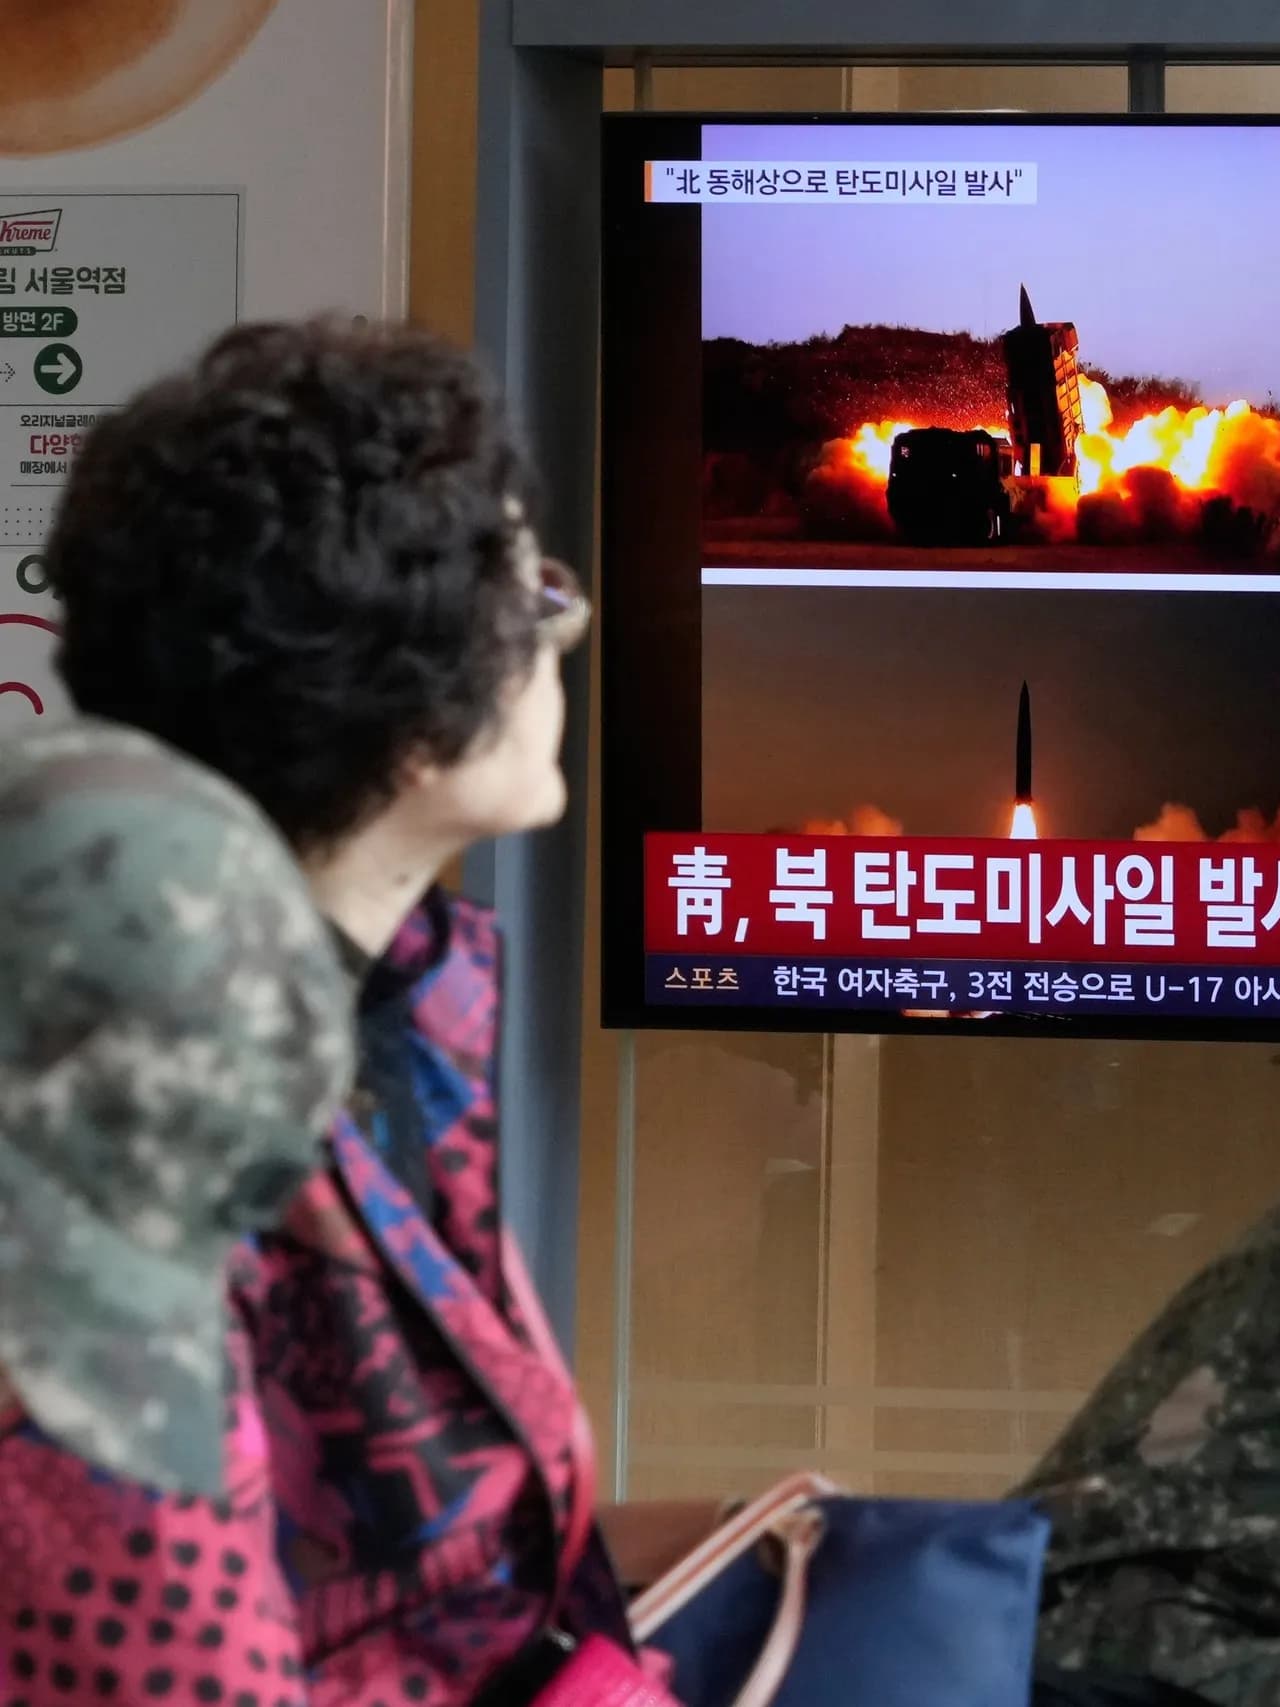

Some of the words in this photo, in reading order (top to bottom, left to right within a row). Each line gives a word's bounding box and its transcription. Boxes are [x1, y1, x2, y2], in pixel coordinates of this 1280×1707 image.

[666, 167, 701, 194] "北
[706, 168, 829, 196] 동해상으로
[836, 168, 957, 197] 탄도미사일
[965, 168, 1022, 197] 발사"
[25, 266, 126, 294] 서울역점
[3, 311, 36, 332] 방면
[41, 313, 64, 331] 2F
[769, 848, 833, 940] 북
[854, 850, 1175, 946] 탄도미사일
[664, 967, 740, 990] 스포츠
[773, 965, 827, 997] 한국
[838, 967, 956, 1001] 여자축구,
[968, 971, 1012, 1000] 3전
[1024, 971, 1135, 1002] 전승으로
[1146, 975, 1223, 1003] U-17
